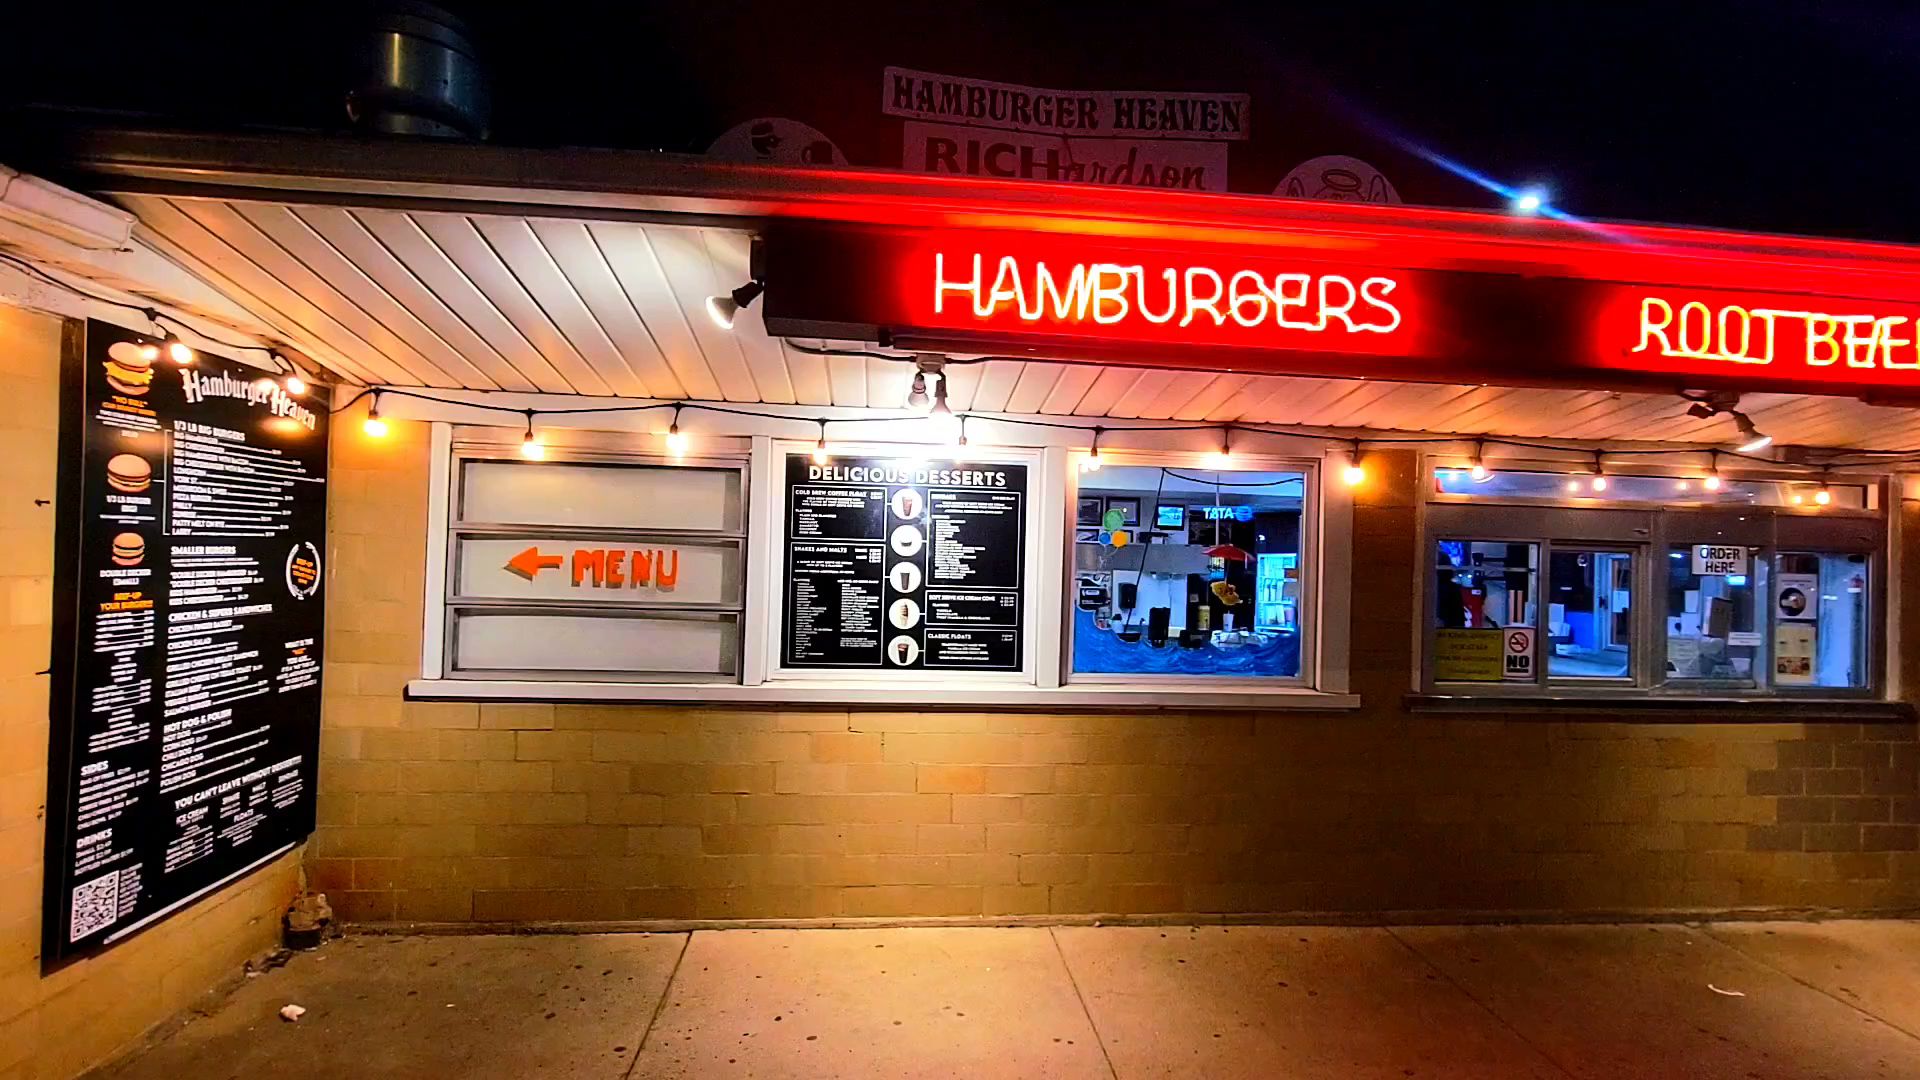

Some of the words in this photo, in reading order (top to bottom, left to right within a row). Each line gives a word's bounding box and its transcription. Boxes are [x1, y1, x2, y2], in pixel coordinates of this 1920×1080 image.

[893, 75, 1098, 130] HAMBURGER
[1113, 97, 1242, 133] HEAVEN
[935, 253, 1400, 334] HAMBURGERS
[1631, 297, 1775, 364] ROOT
[1806, 312, 1920, 370] BEE
[178, 368, 269, 406] Hamburger
[270, 384, 316, 430] Heaven
[809, 466, 910, 484] DELICIOUS
[914, 470, 1006, 487] DESSERTS
[572, 549, 677, 590] MENU
[1700, 547, 1740, 560] ORDER
[1705, 561, 1735, 573] HERE
[1506, 655, 1529, 668] NO
[182, 717, 200, 729] DOG
[175, 795, 194, 810] YOU
[218, 778, 241, 794] LEAVE
